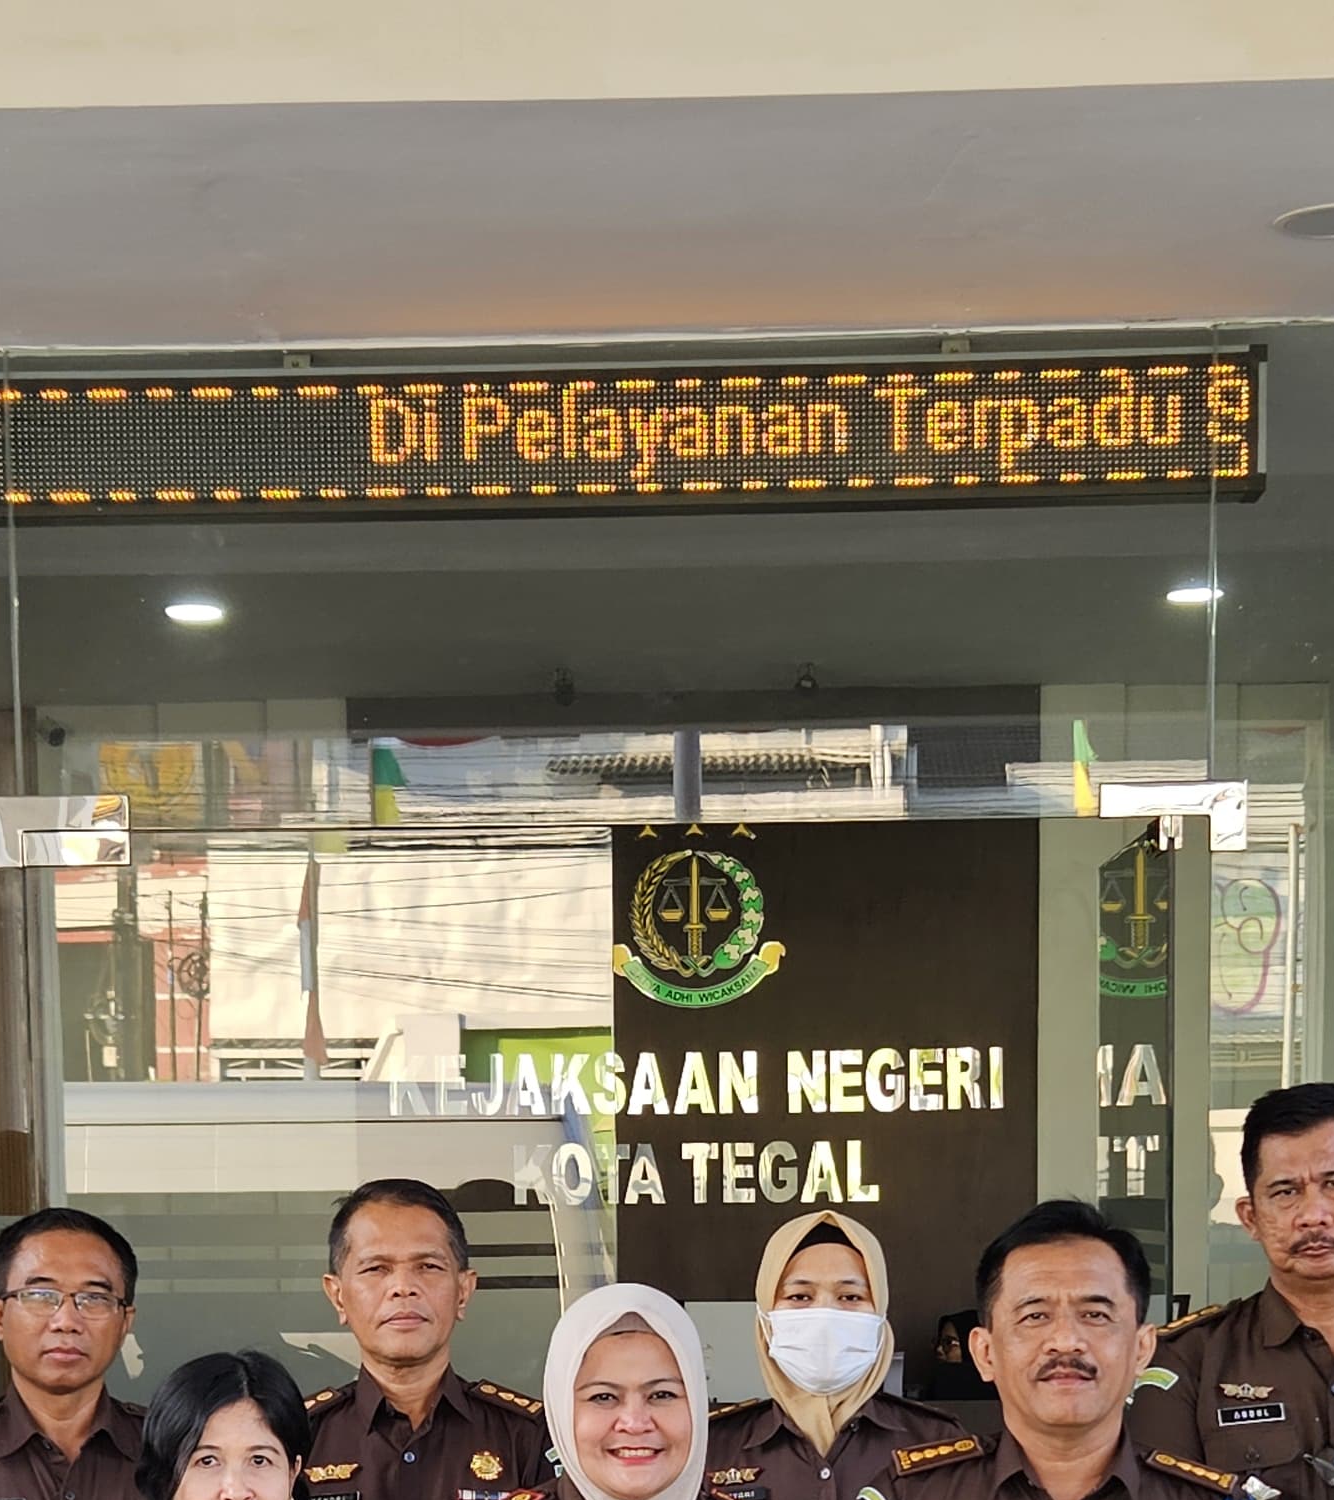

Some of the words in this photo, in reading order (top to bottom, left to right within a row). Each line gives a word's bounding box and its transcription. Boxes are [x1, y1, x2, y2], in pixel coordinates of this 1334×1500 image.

[370, 397, 439, 463] Di
[463, 384, 849, 484] Pelayanan
[874, 374, 1182, 470] Terpadu
[666, 991, 693, 1003] ADHI
[698, 966, 763, 1003] WICAKSANA
[387, 1050, 759, 1116] KEJAKSAAN
[786, 1047, 1005, 1114] NEGERI
[513, 1142, 667, 1206] KOTA
[681, 1139, 880, 1204] TEGAL
